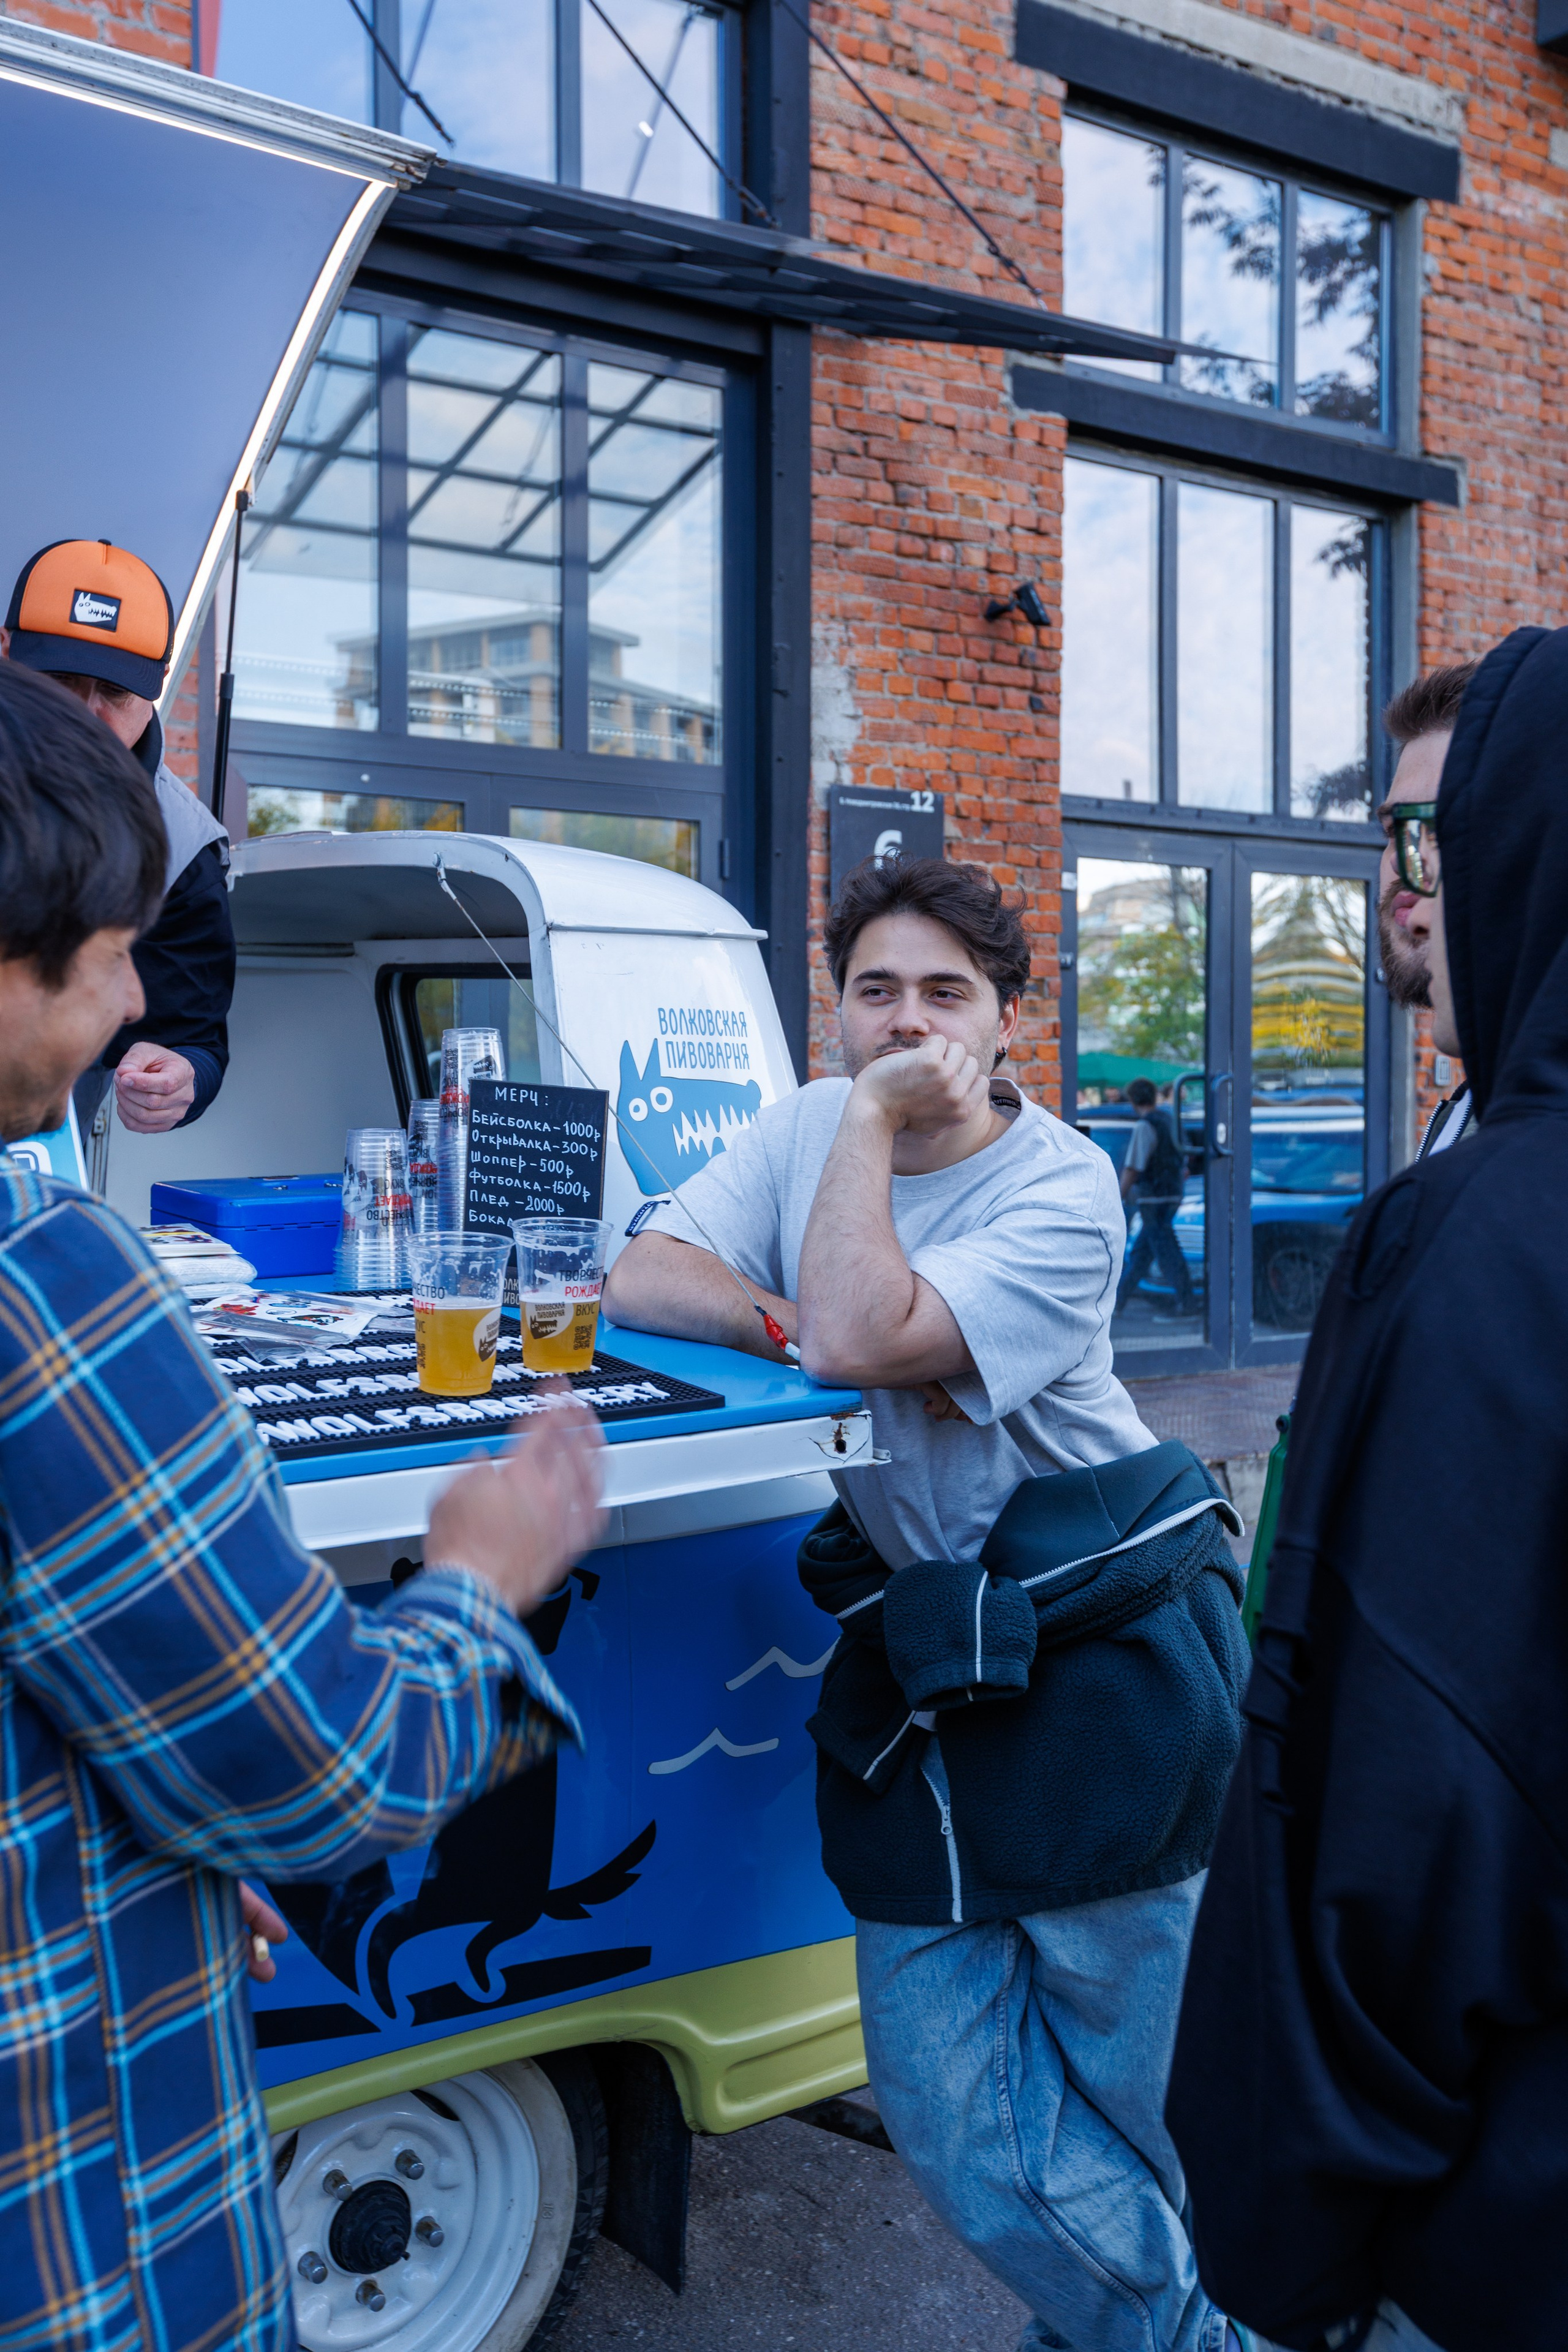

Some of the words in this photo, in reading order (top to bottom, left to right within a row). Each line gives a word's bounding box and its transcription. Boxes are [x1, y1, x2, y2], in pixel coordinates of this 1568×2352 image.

[910, 791, 935, 813] 12
[658, 1008, 748, 1038] ВОЛКОВСКАЯ
[665, 1041, 750, 1069] ПИВОВАРНЯ
[575, 1303, 596, 1316] ВКУС
